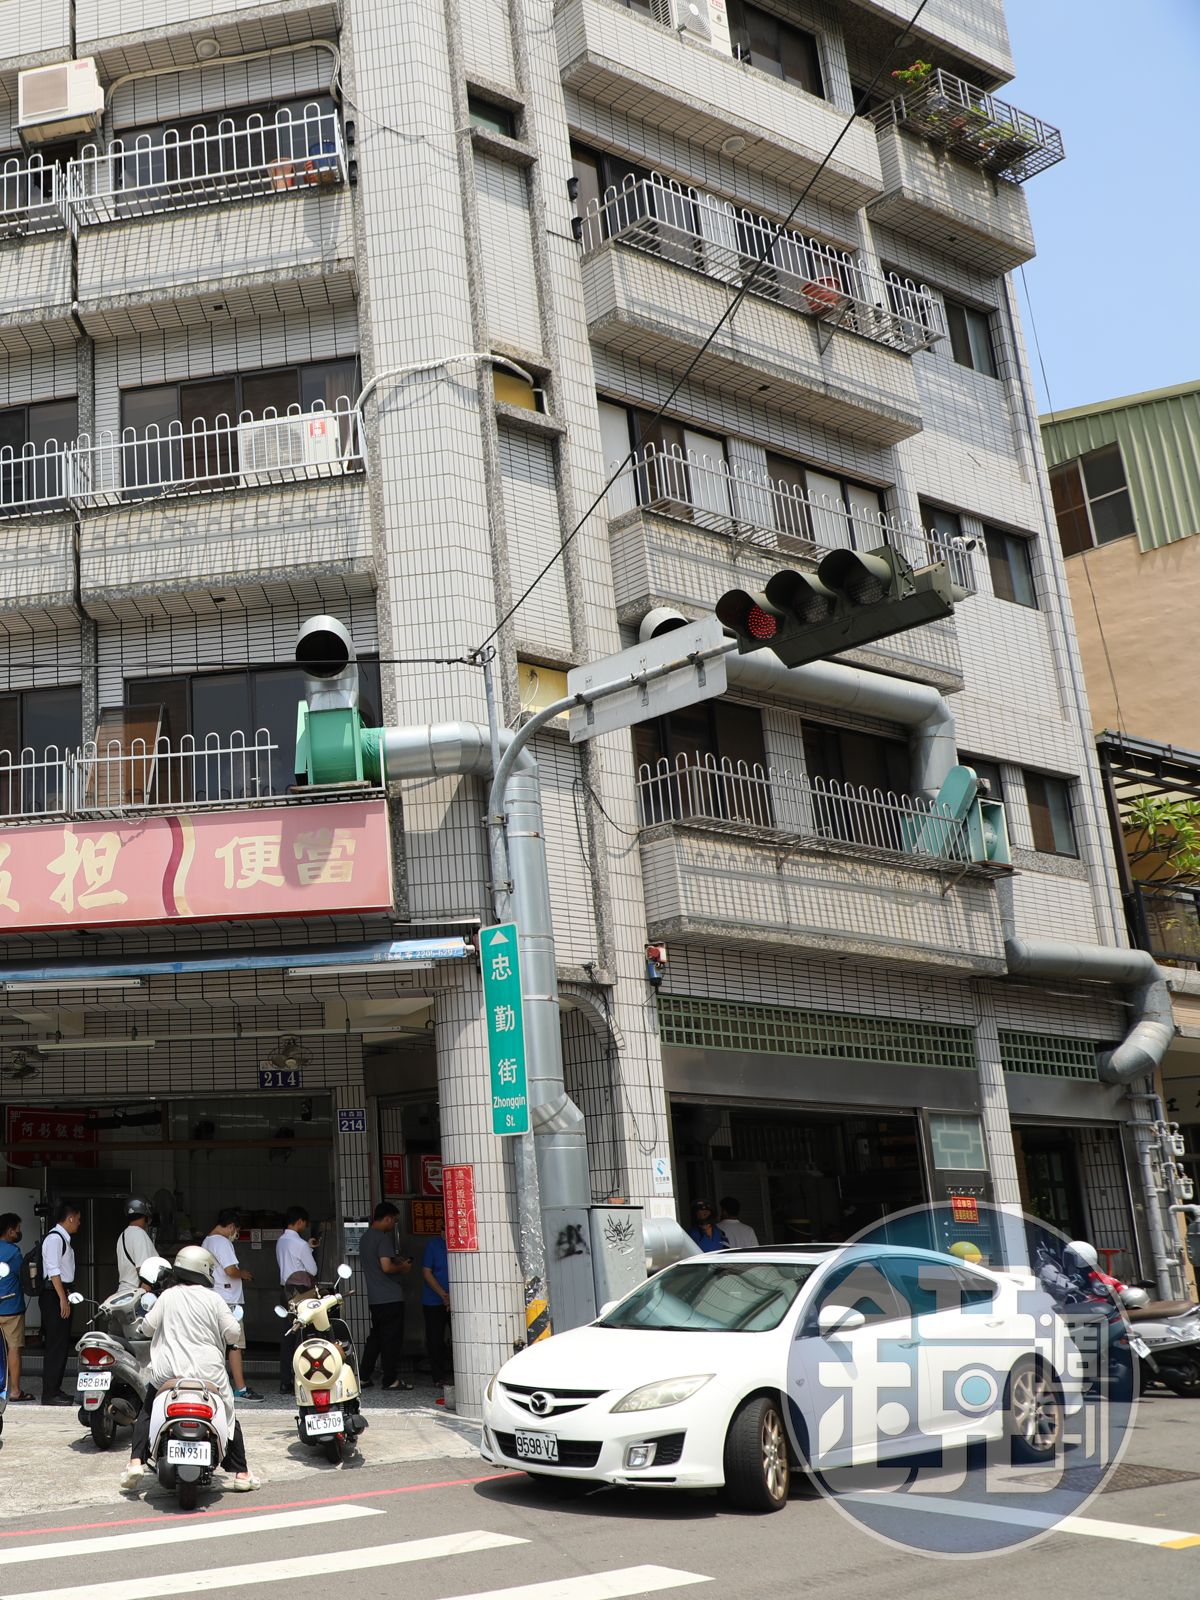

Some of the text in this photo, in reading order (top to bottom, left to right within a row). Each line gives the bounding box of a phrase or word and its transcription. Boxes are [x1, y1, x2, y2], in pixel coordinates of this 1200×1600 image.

[215, 826, 357, 890] 便當
[490, 952, 519, 1086] 忠勤街
[264, 1072, 296, 1086] 214
[493, 1095, 526, 1110] Zhongqin
[341, 1120, 363, 1131] 214
[505, 1115, 516, 1127] St.
